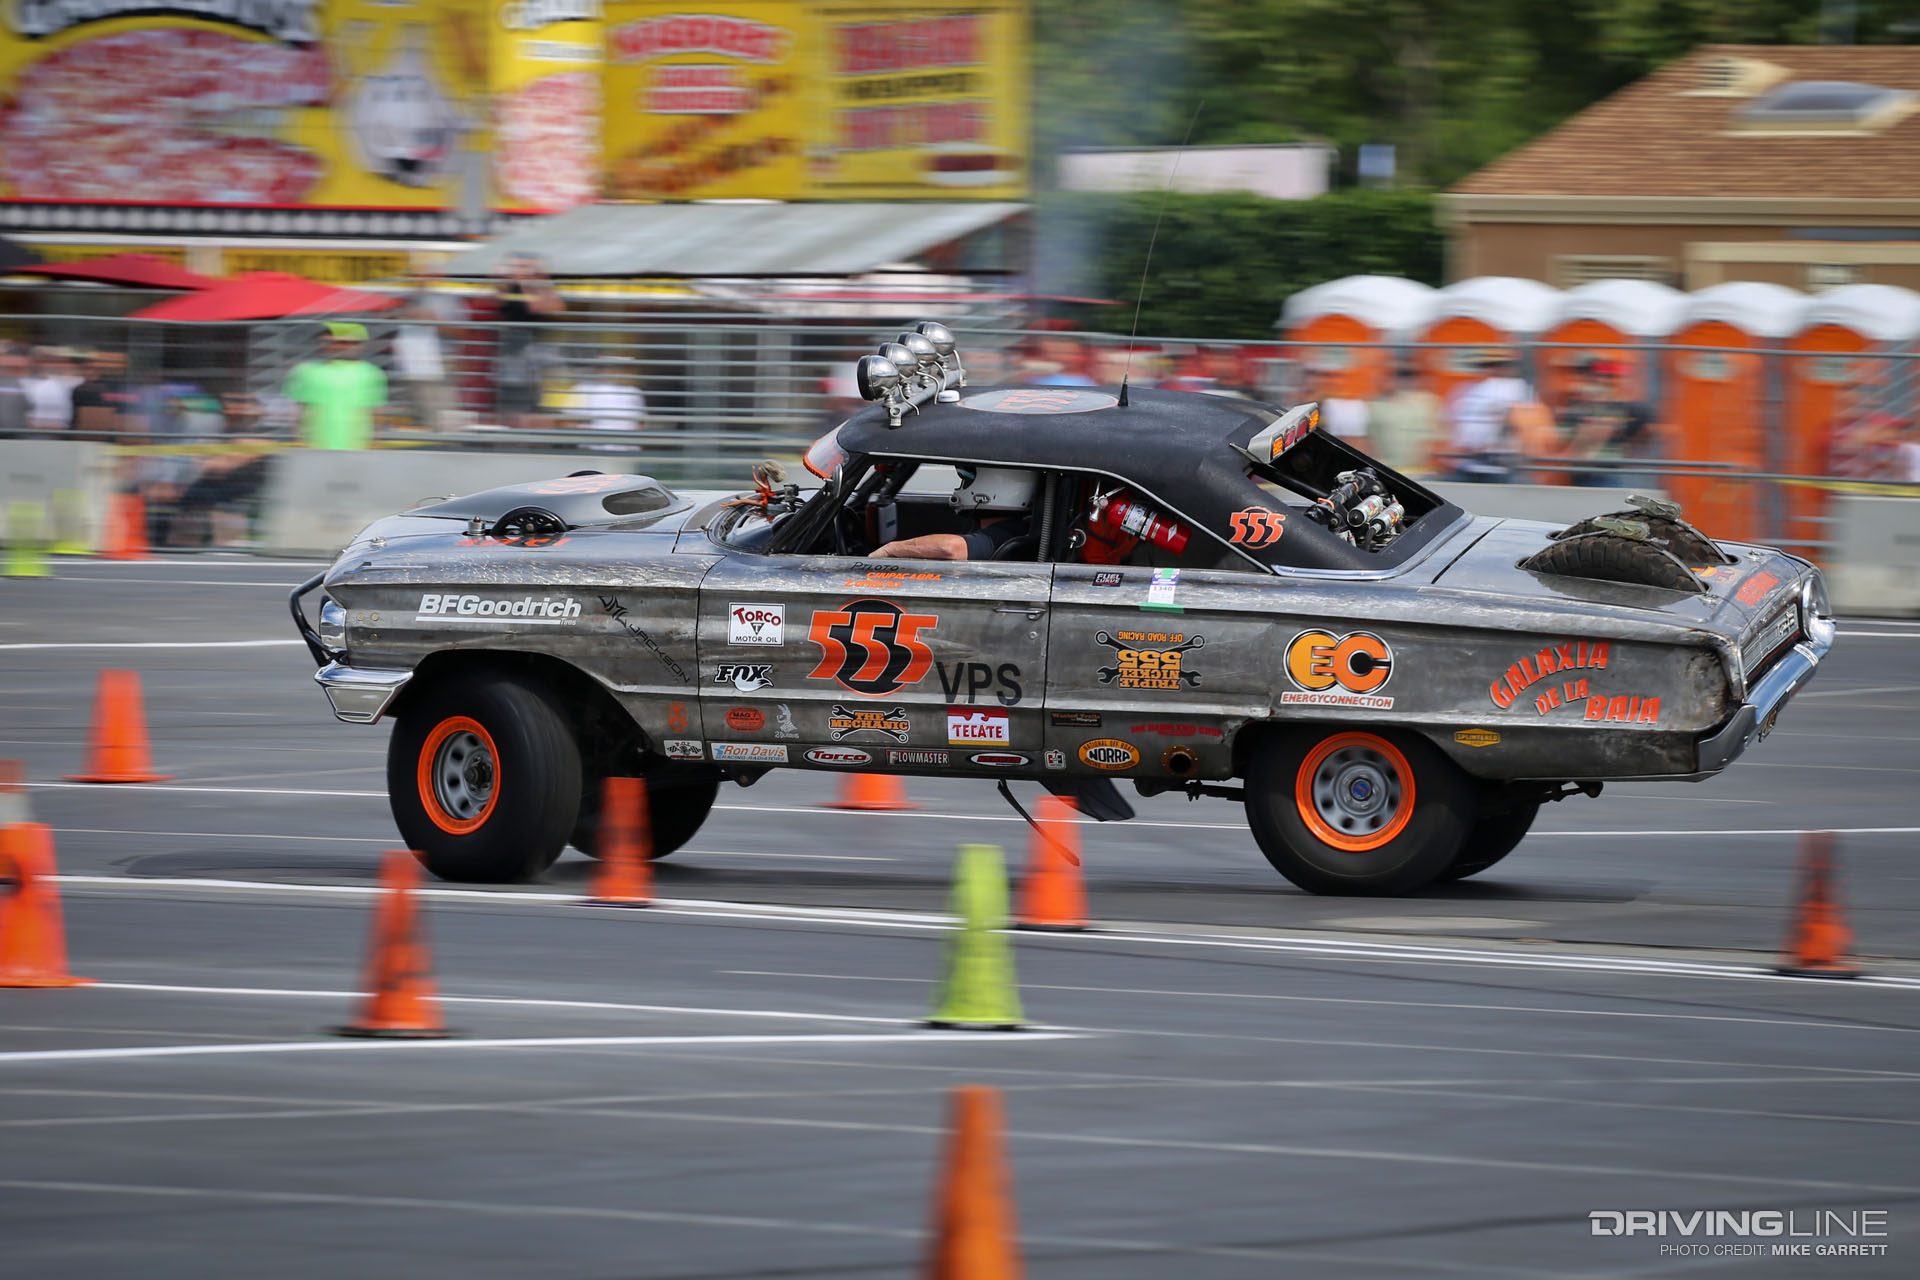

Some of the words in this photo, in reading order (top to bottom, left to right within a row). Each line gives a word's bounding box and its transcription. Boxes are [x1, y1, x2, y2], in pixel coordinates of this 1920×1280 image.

[1229, 512, 1286, 543] 555
[866, 571, 942, 581] CHUPACABRA
[418, 594, 582, 617] BFGoodrich
[733, 607, 782, 626] TORCO
[735, 635, 763, 643] MOTOR
[1118, 631, 1145, 641] RACING
[1147, 632, 1168, 642] ROAD
[1169, 633, 1183, 643] OFF
[629, 624, 690, 683] JACKSON
[807, 610, 939, 683] 555
[1117, 649, 1182, 670] 555
[714, 663, 773, 686] FOX
[1118, 668, 1180, 680] NICKEL
[1490, 641, 1610, 709] GALAXIA
[935, 661, 1023, 706] VPS
[1119, 678, 1180, 690] TRIPLE
[1282, 693, 1392, 708] ENERGYCONNECTION
[1534, 687, 1562, 716] DE
[1564, 678, 1590, 703] LA
[855, 711, 885, 721] THE
[1583, 695, 1661, 724] BAJA
[830, 719, 909, 730] MECHANIC
[952, 724, 1003, 738] TECATE
[724, 745, 749, 756] Ron
[751, 746, 786, 757] Davis
[812, 750, 868, 762] Torco
[890, 751, 949, 765] FLOWMASTER
[1089, 748, 1131, 763] NORRA
